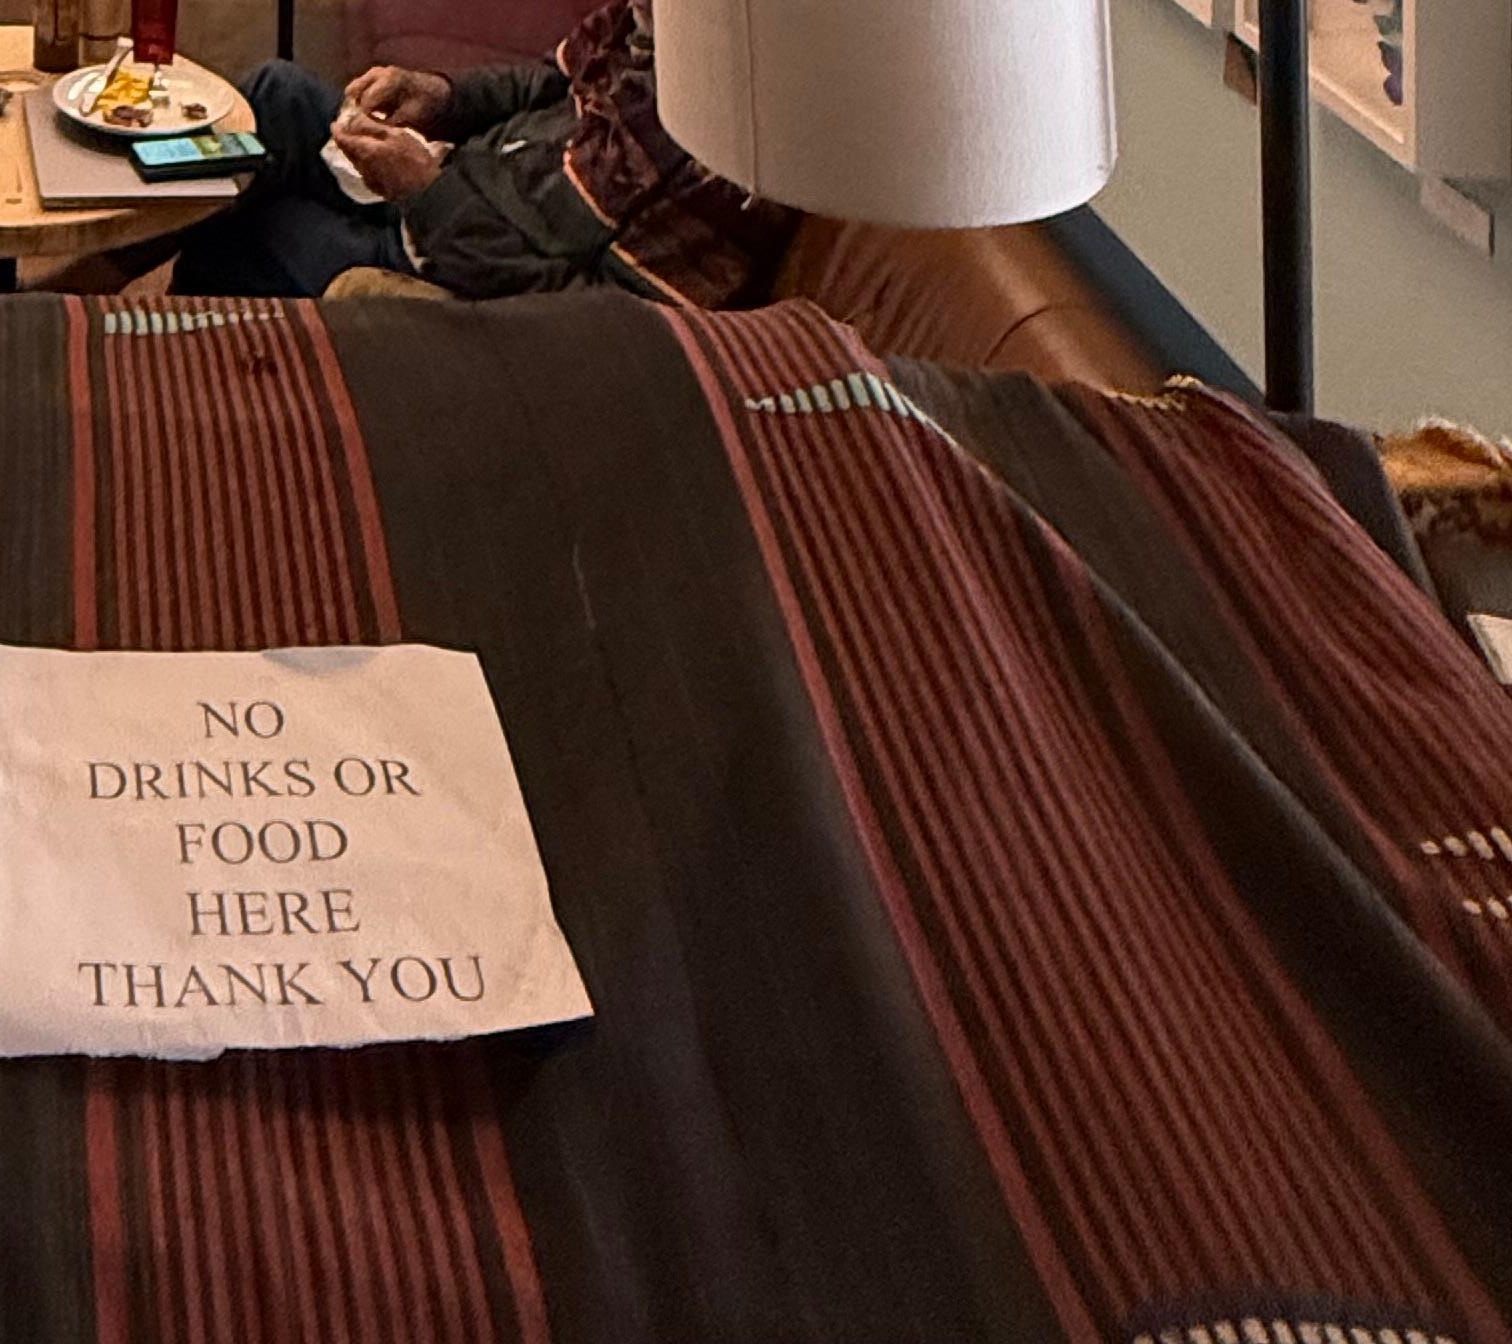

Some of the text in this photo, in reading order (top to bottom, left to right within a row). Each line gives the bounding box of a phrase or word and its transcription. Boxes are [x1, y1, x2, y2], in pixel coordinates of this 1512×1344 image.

[198, 701, 285, 740] NO
[87, 757, 422, 802] DRINKS OR
[176, 820, 348, 865] FOOD
[187, 889, 361, 937] HERE
[78, 955, 486, 1008] THANK YOU
